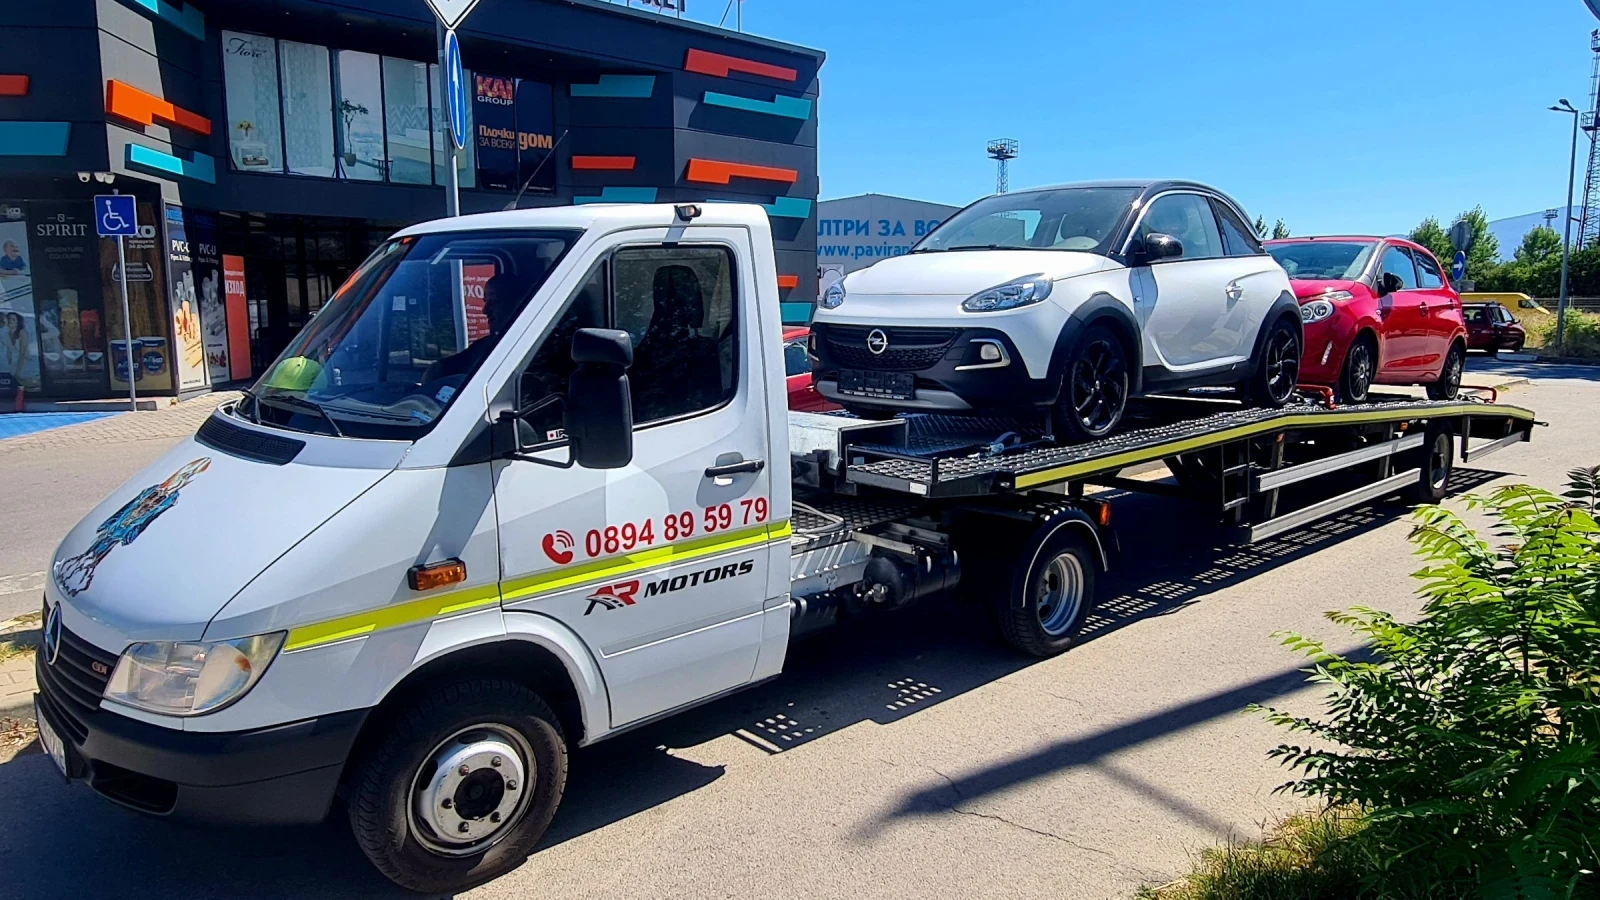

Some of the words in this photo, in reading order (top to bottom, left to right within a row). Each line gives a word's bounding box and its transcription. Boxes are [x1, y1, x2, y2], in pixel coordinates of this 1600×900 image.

[477, 95, 513, 106] GROUP
[479, 124, 515, 140] Плочки
[479, 136, 490, 147] ЗА
[491, 138, 515, 149] ВСЕКИ
[518, 132, 553, 151] дом
[37, 224, 87, 236] SPIRIT
[878, 219, 906, 236] ЗА
[225, 279, 245, 297] ИЗХОД
[585, 518, 654, 558] 0894
[663, 511, 694, 541] 89
[703, 503, 732, 533] 59
[740, 496, 768, 525] 79
[643, 559, 754, 598] MOTORS
